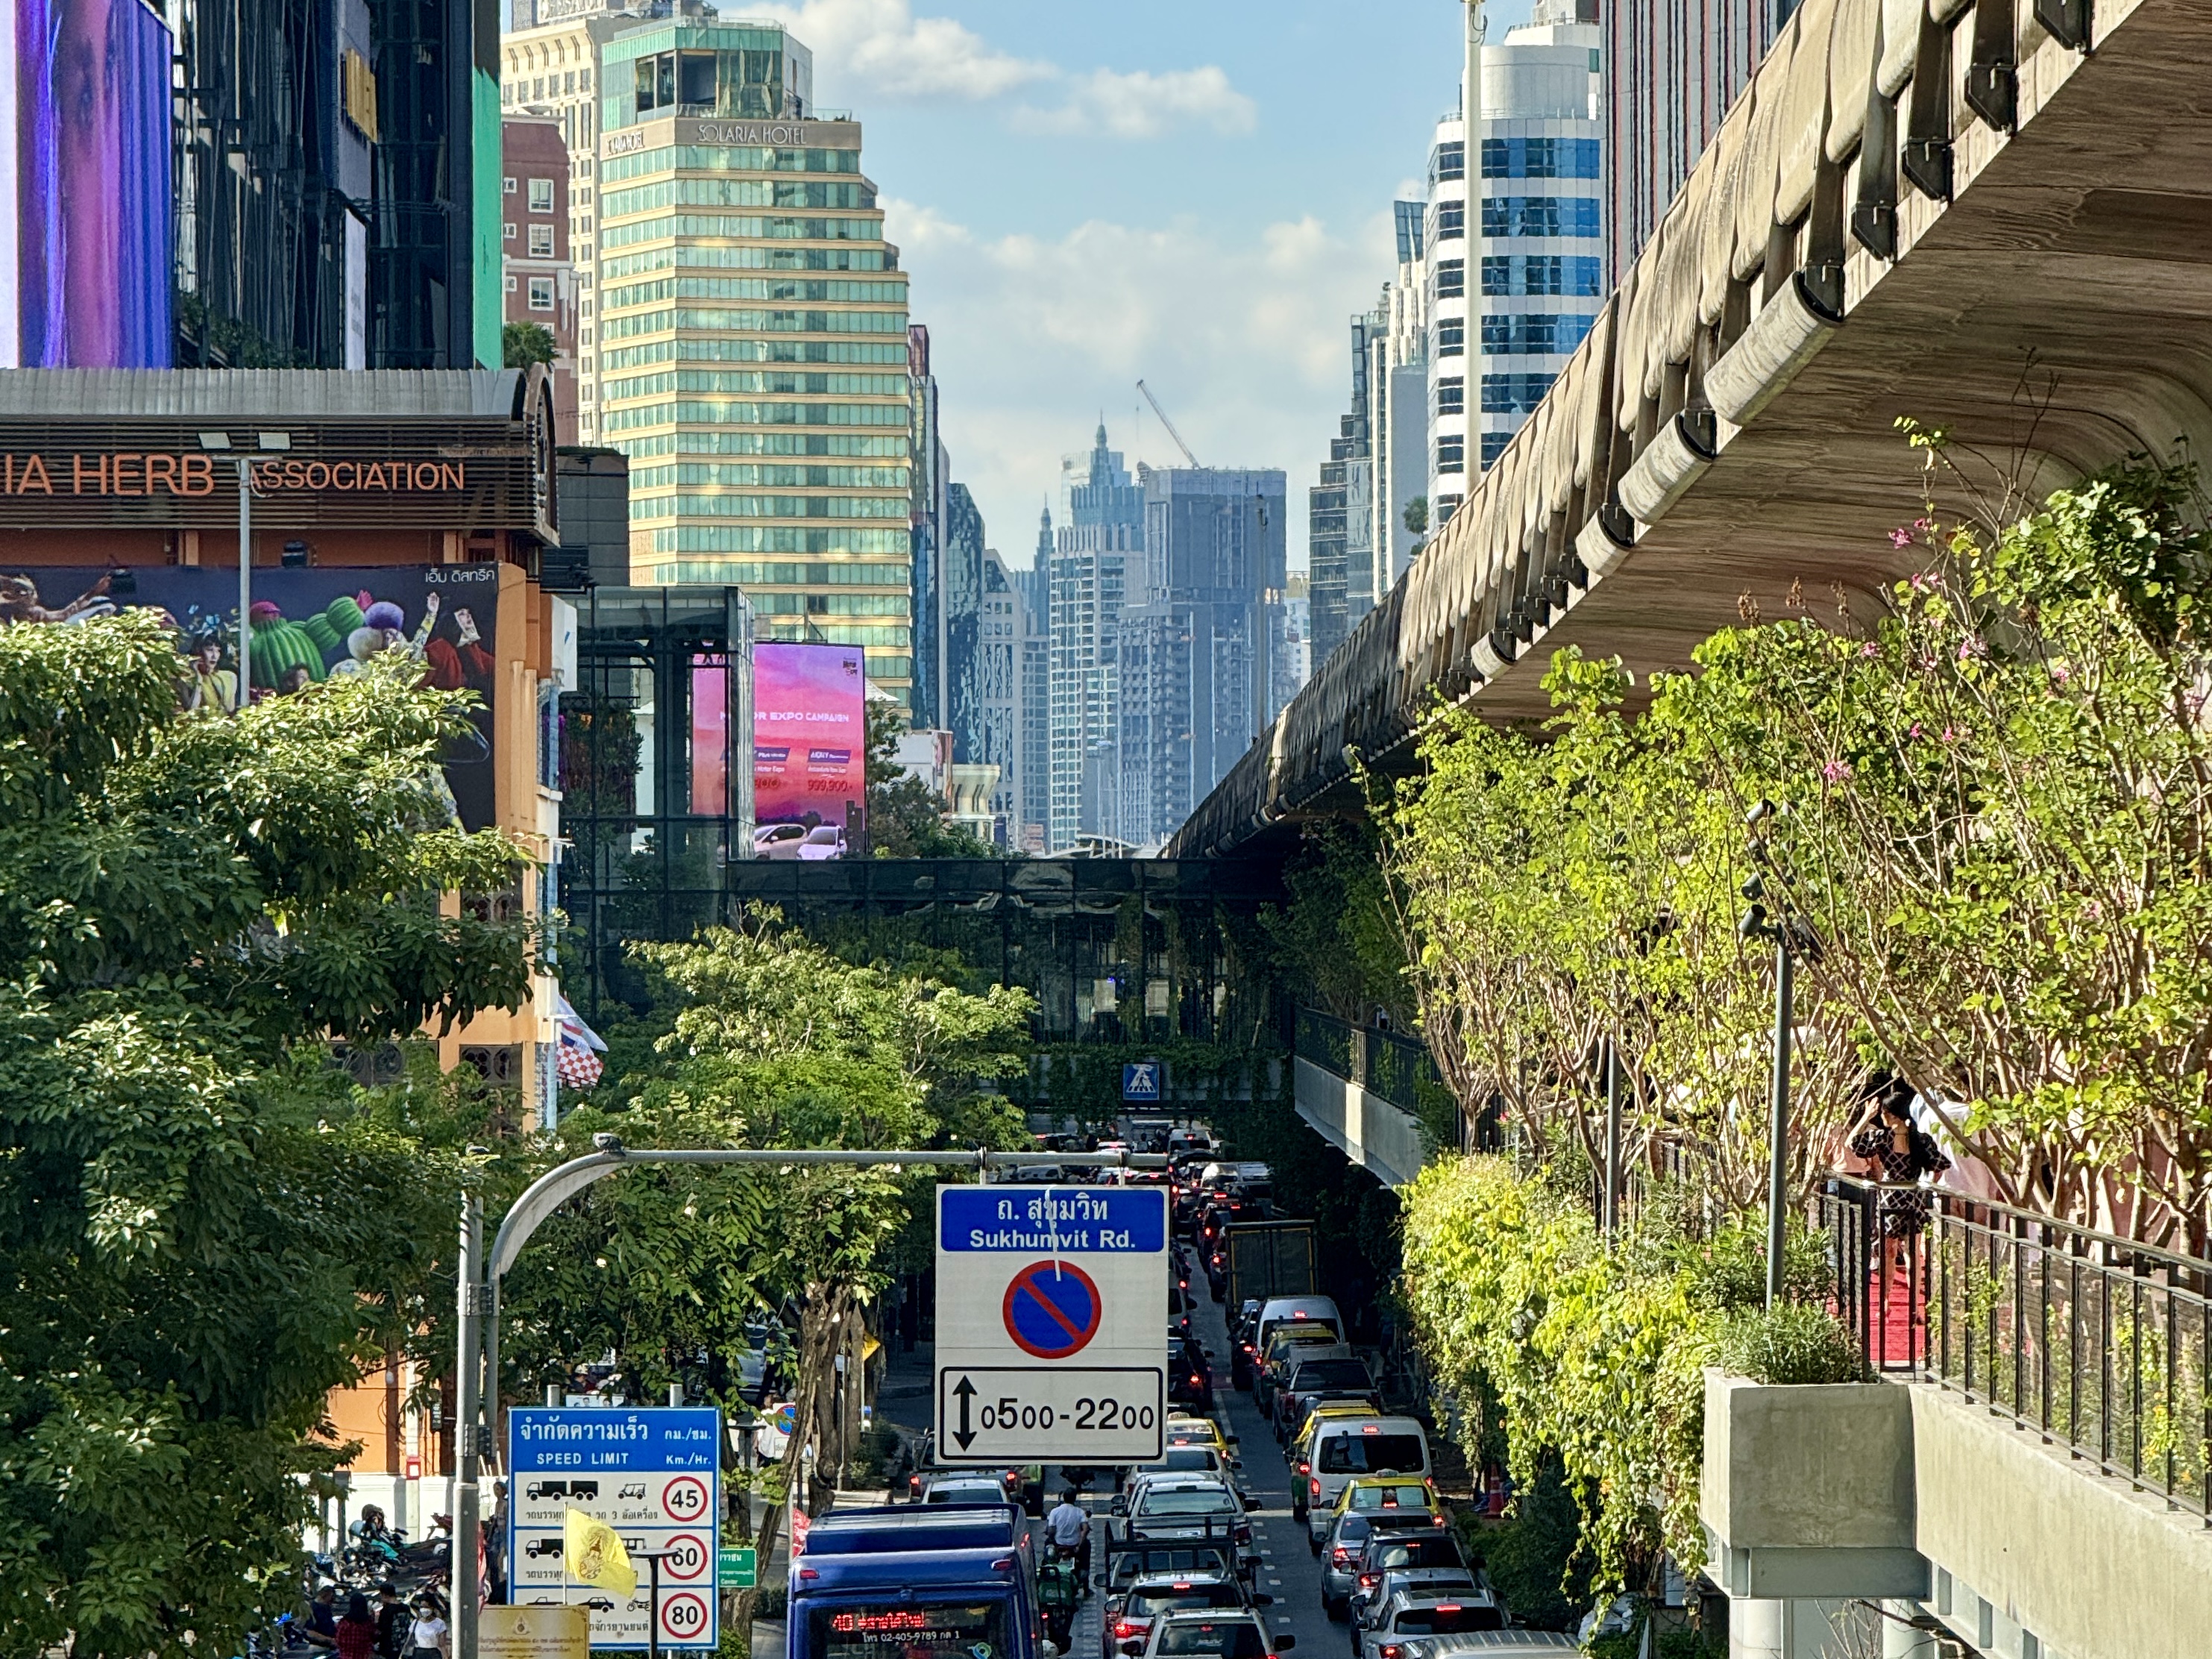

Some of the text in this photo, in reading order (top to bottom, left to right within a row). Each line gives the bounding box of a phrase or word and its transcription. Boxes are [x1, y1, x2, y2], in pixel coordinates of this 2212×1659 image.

[699, 125, 806, 145] SOLARIA HOTEL
[73, 454, 214, 496] HERB
[770, 712, 803, 721] EXPO
[805, 712, 849, 723] CAMPAIGN
[997, 1191, 1107, 1229] ถ. สุขุมวิท
[970, 1229, 1136, 1249] Sukhumvit Rd.
[520, 1414, 711, 1441] จำกัดความเร็ว กม./ชม.
[537, 1452, 711, 1466] SPEED LIMIT Km./Hr.
[670, 1489, 699, 1508] 45
[612, 1511, 618, 1520] 3
[673, 1546, 698, 1567] 60
[672, 1606, 699, 1625] 80
[881, 1631, 937, 1643] 02-405-9789
